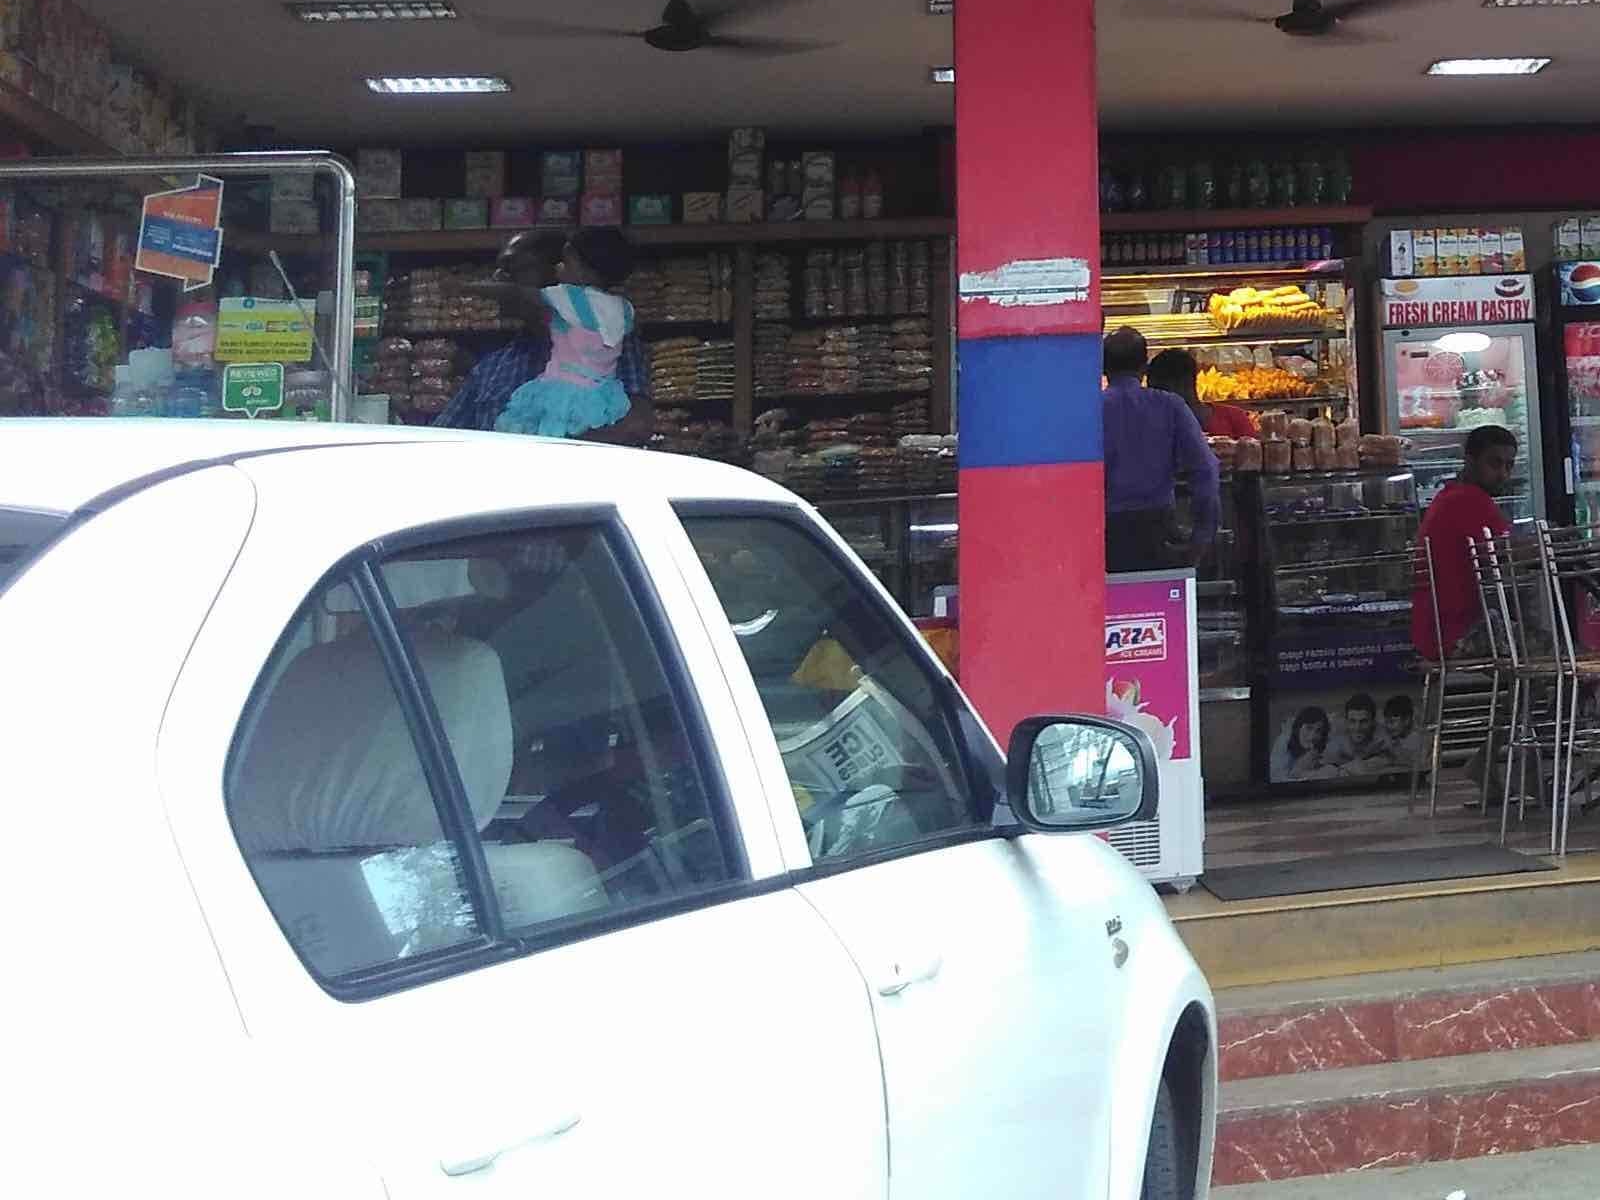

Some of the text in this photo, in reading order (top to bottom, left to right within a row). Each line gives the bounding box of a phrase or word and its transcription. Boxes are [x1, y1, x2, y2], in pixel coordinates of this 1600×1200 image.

[1389, 299, 1531, 324] FRESH CREAM PASTRY
[1106, 627, 1158, 649] AZZA
